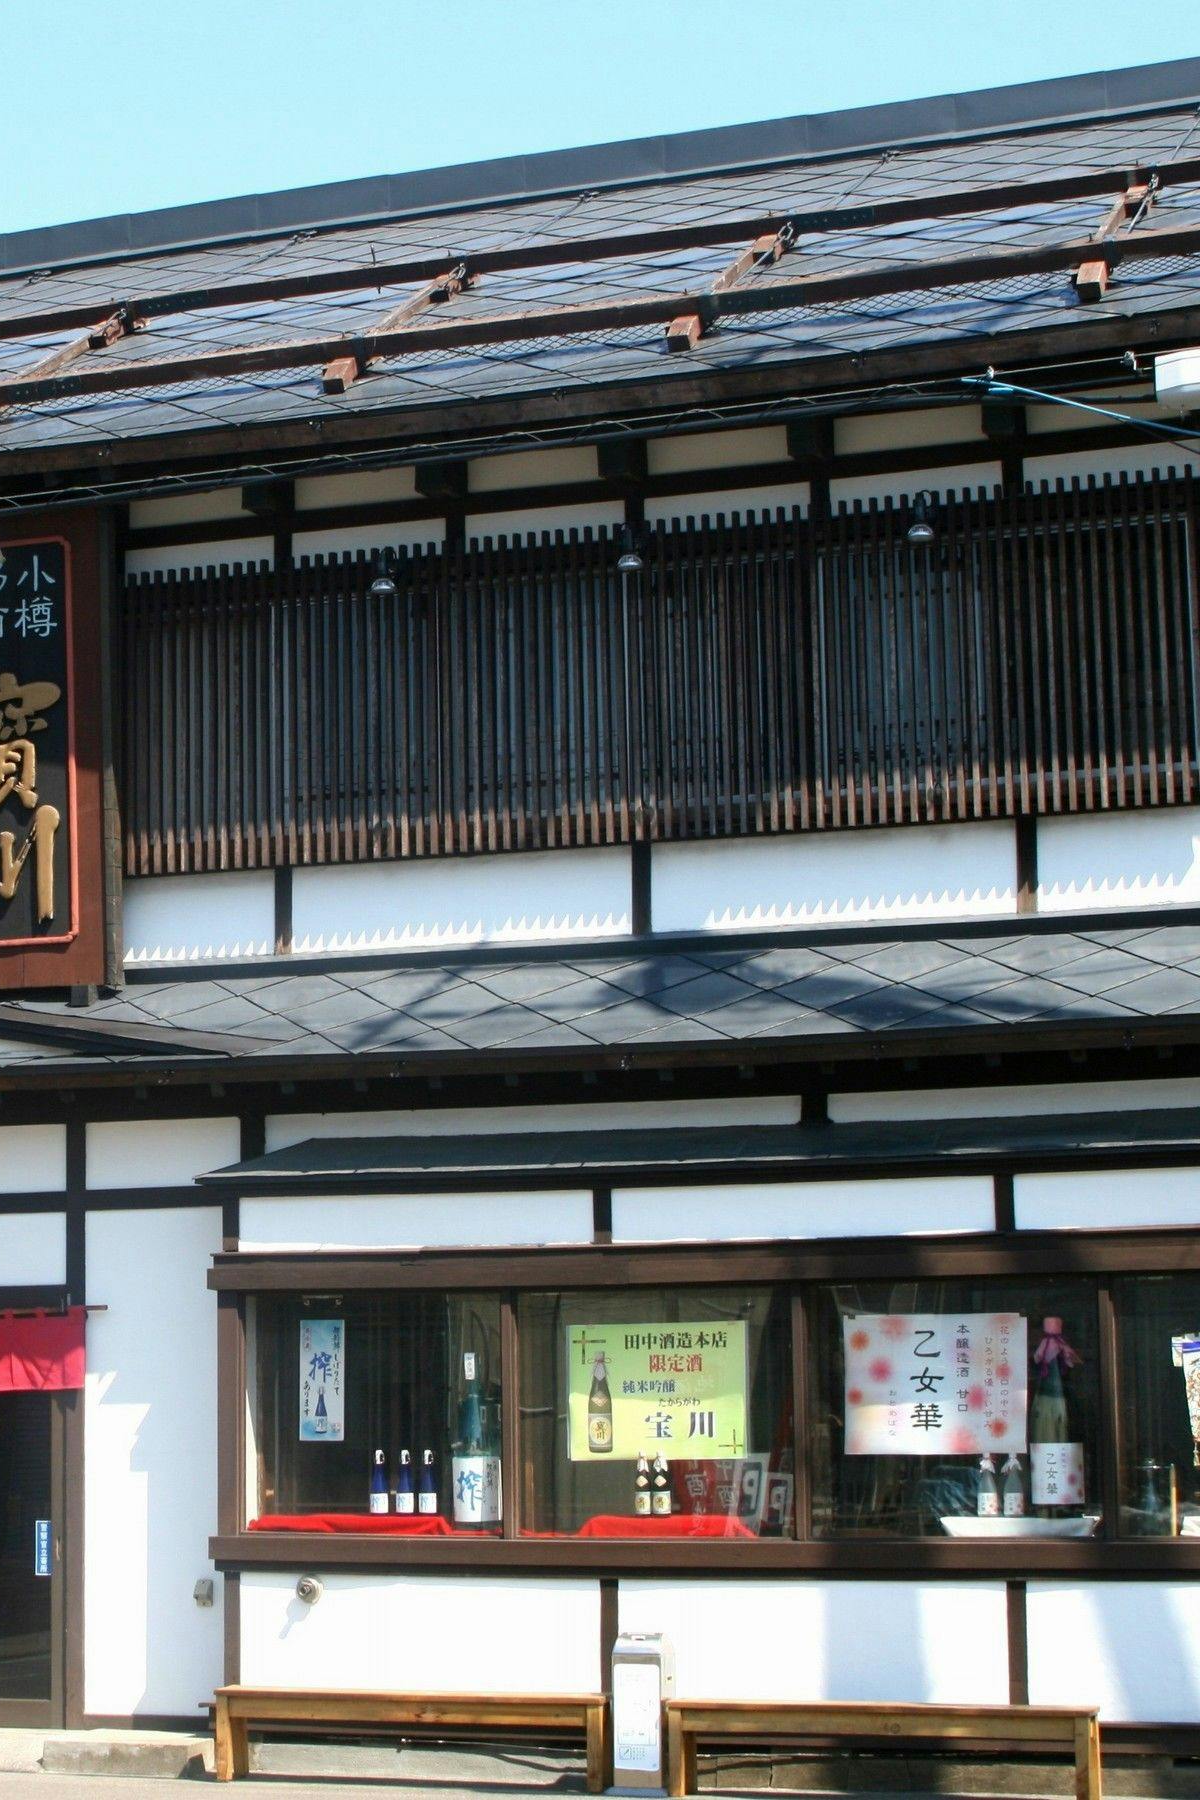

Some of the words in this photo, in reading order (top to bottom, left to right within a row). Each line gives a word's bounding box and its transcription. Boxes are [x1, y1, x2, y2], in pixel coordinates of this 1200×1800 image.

[13, 554, 58, 639] 小樽
[624, 1331, 728, 1350] 田中酒造本店
[649, 1353, 704, 1373] 限定酒
[622, 1379, 678, 1394] 純米吟醸
[909, 1330, 945, 1432] 乙女華
